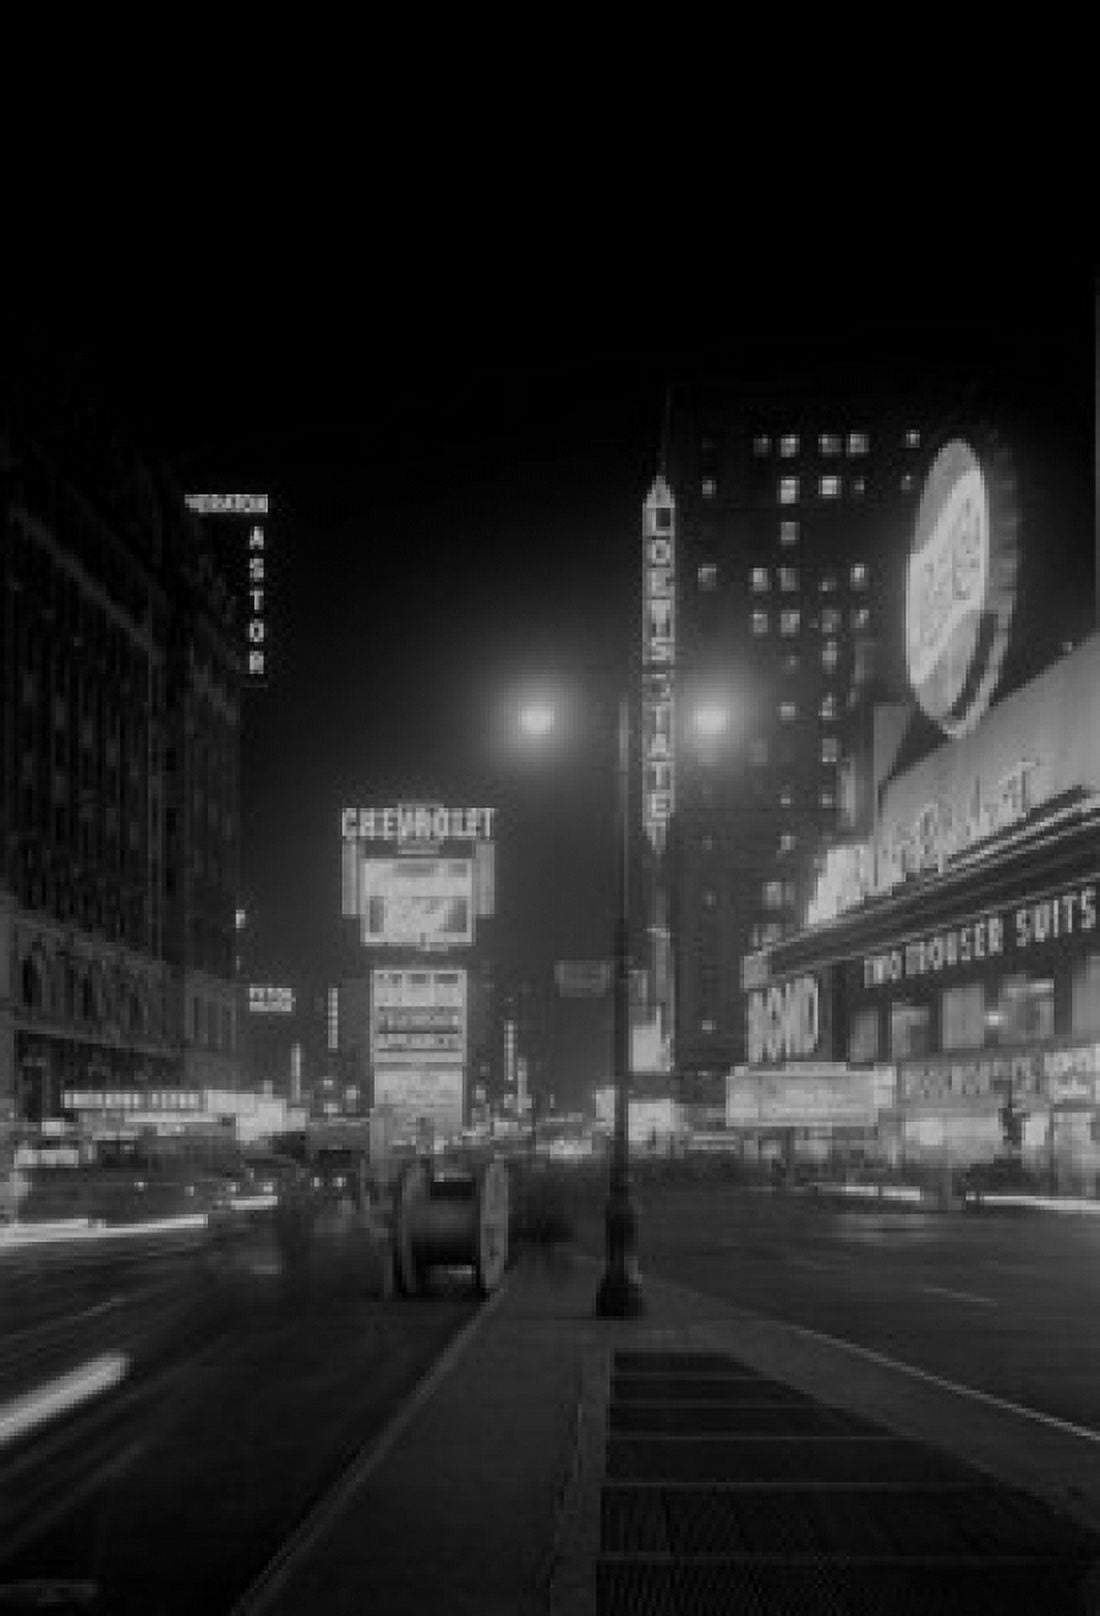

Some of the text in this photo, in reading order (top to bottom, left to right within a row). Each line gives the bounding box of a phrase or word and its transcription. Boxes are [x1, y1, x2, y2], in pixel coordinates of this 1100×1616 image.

[249, 525, 265, 676] ASTOR
[341, 806, 496, 841] CHEVROLET
[1016, 885, 1097, 948] SUITS
